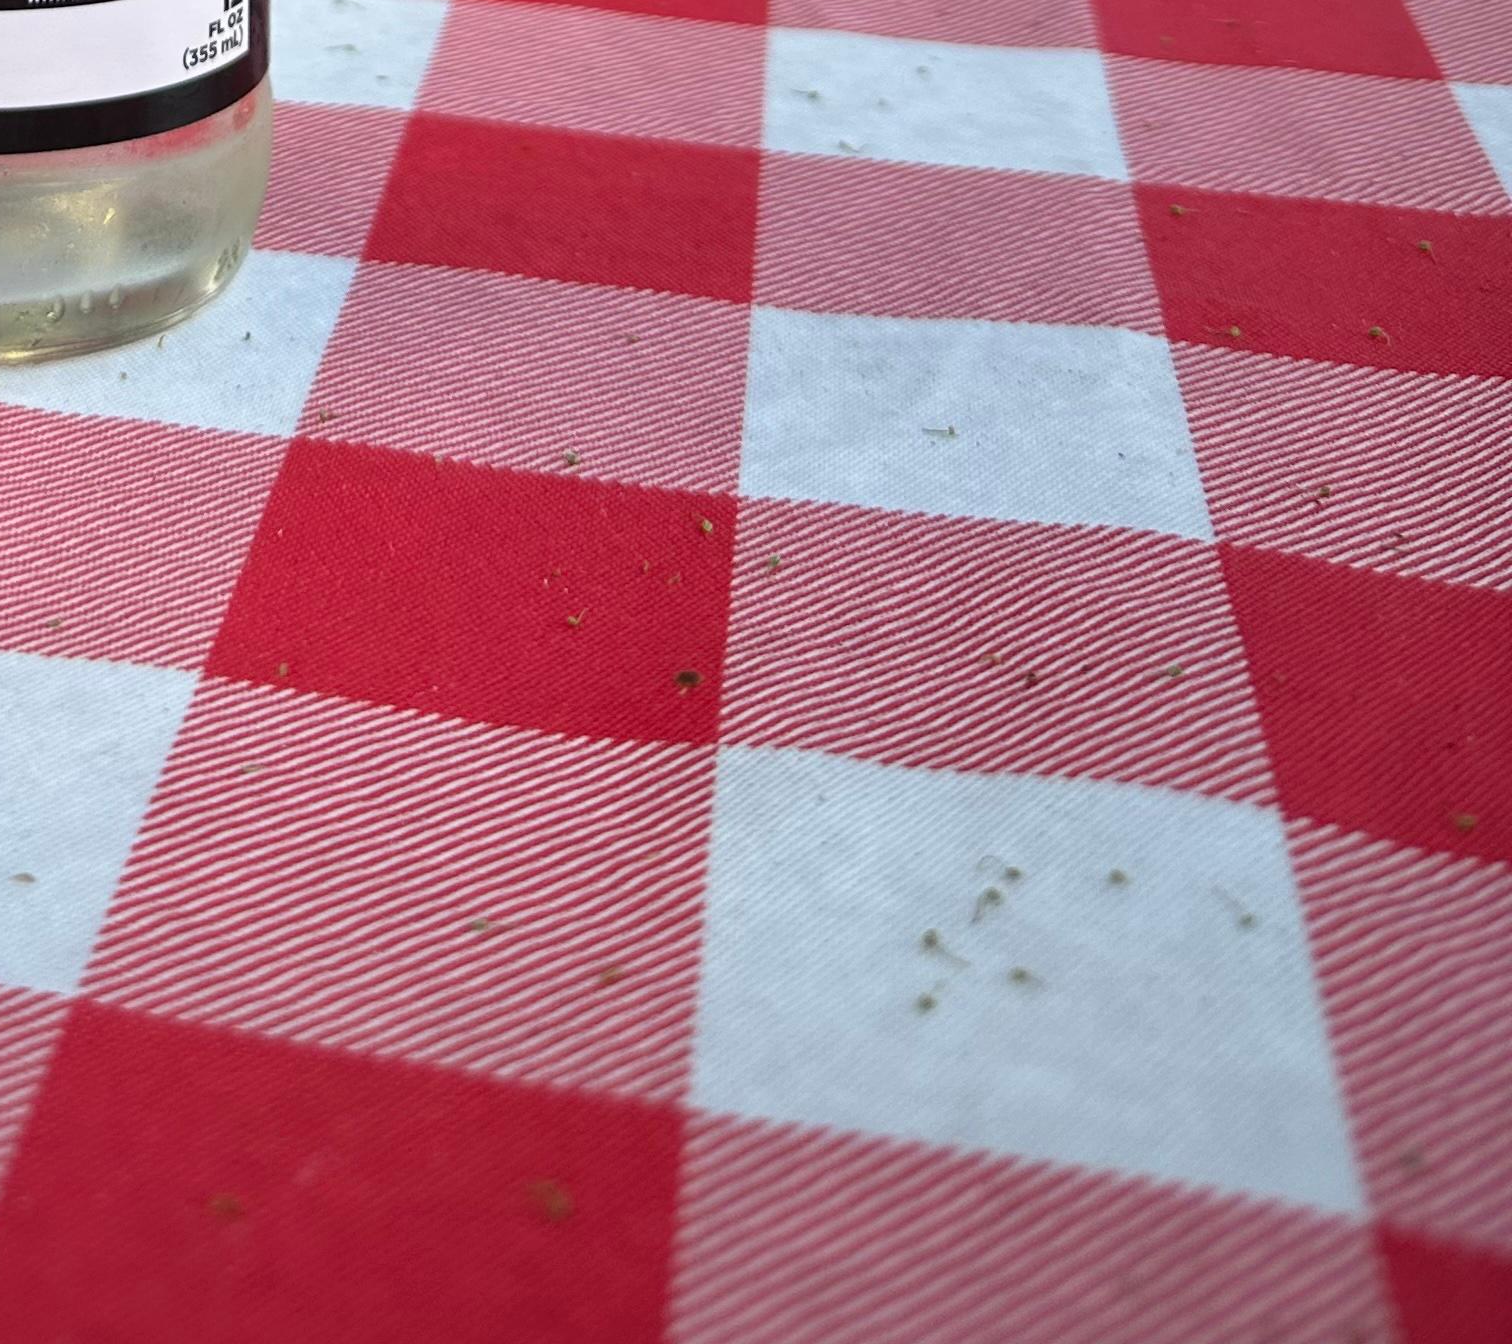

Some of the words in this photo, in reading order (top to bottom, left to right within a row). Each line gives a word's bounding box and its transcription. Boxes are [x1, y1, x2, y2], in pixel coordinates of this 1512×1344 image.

[209, 21, 225, 38] FL
[228, 7, 244, 28] OZ
[183, 41, 217, 70] (355
